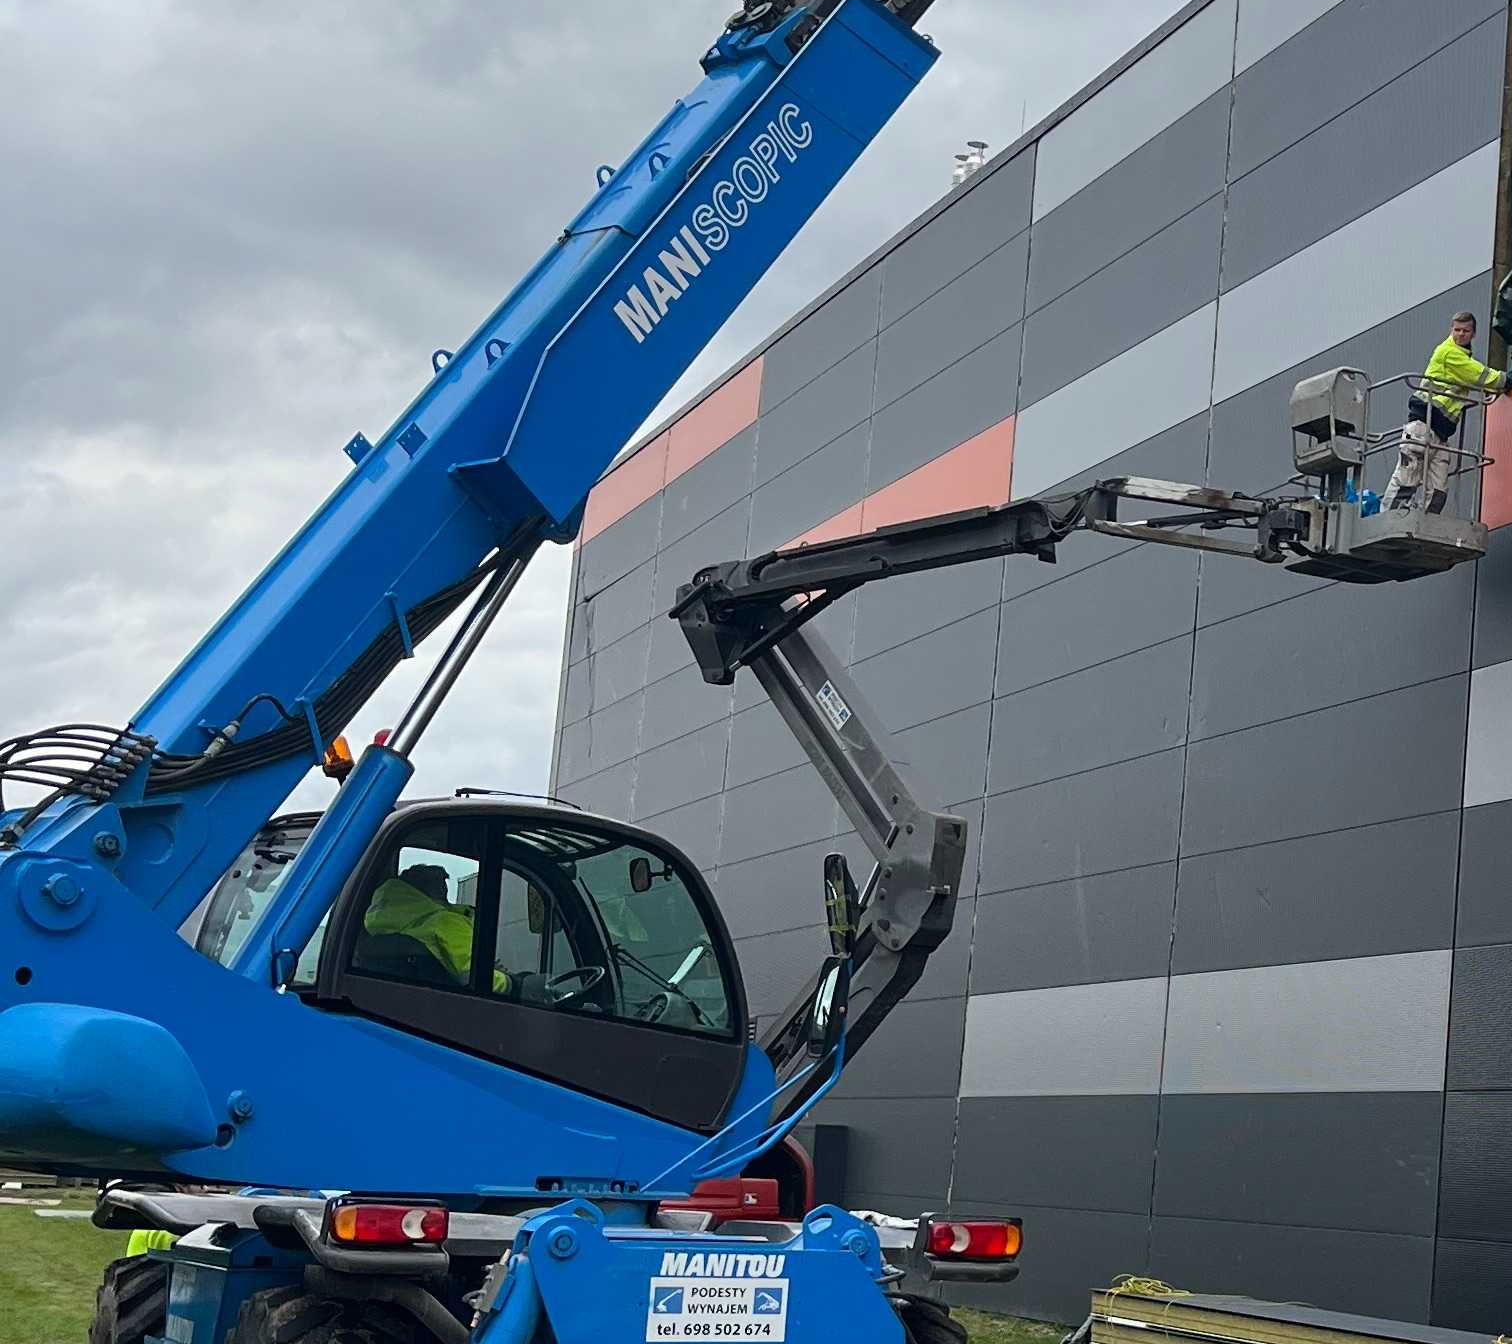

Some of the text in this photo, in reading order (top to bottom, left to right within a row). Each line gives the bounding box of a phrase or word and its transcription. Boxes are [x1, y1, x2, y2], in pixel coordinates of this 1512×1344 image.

[613, 103, 813, 343] MANISCOPIC
[660, 1252, 785, 1277] MANITOU
[691, 1287, 747, 1298] PODESTY
[688, 1303, 748, 1314] WYNAJEM
[657, 1322, 771, 1336] tel. 698 502 674
